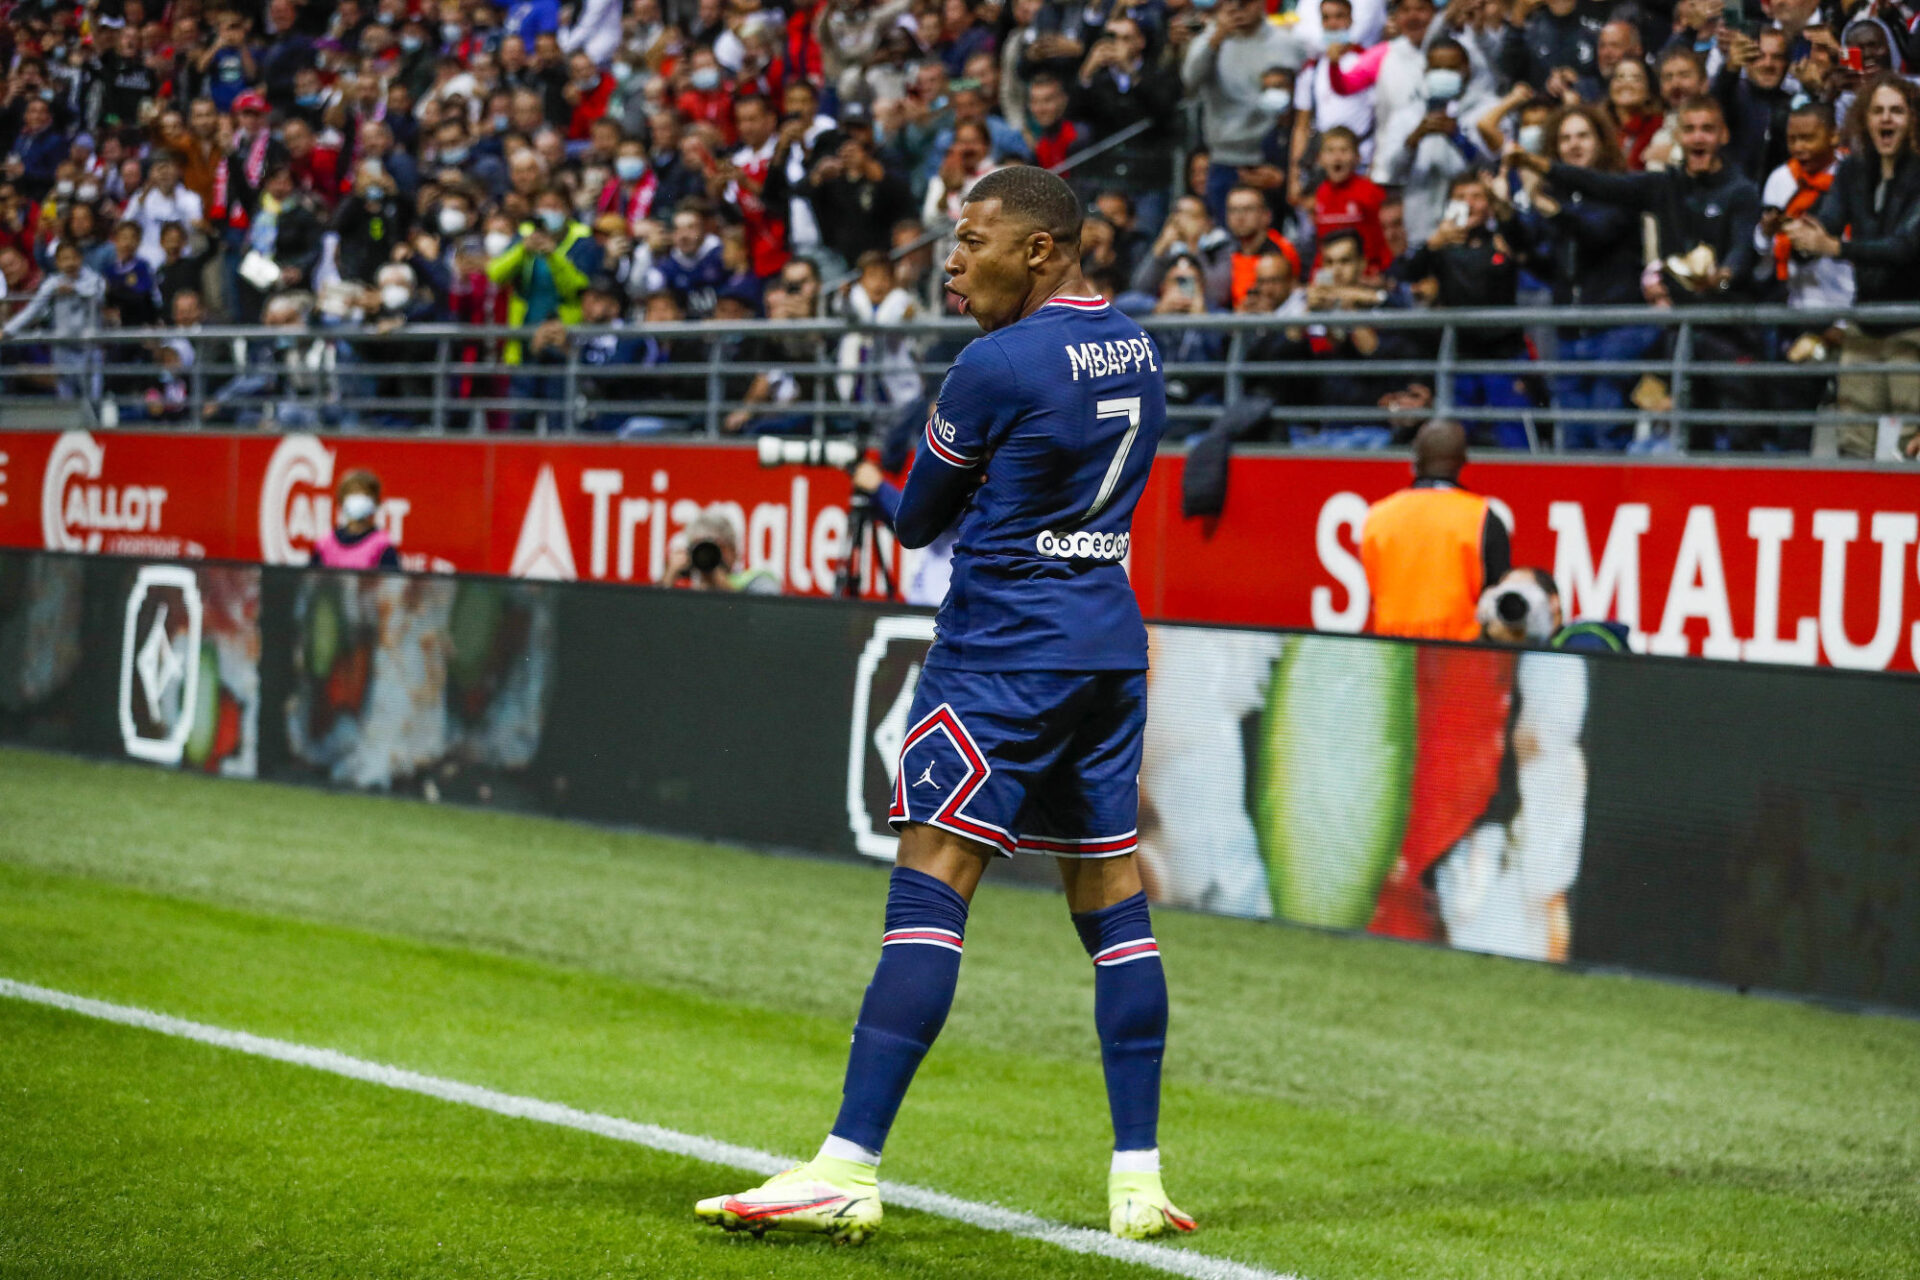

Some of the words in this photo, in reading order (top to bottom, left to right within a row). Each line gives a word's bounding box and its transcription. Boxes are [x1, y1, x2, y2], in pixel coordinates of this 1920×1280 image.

[42, 430, 168, 553] CALLOT
[261, 432, 411, 567] CALT
[1080, 396, 1141, 521] 7
[1548, 501, 1920, 672] MALU
